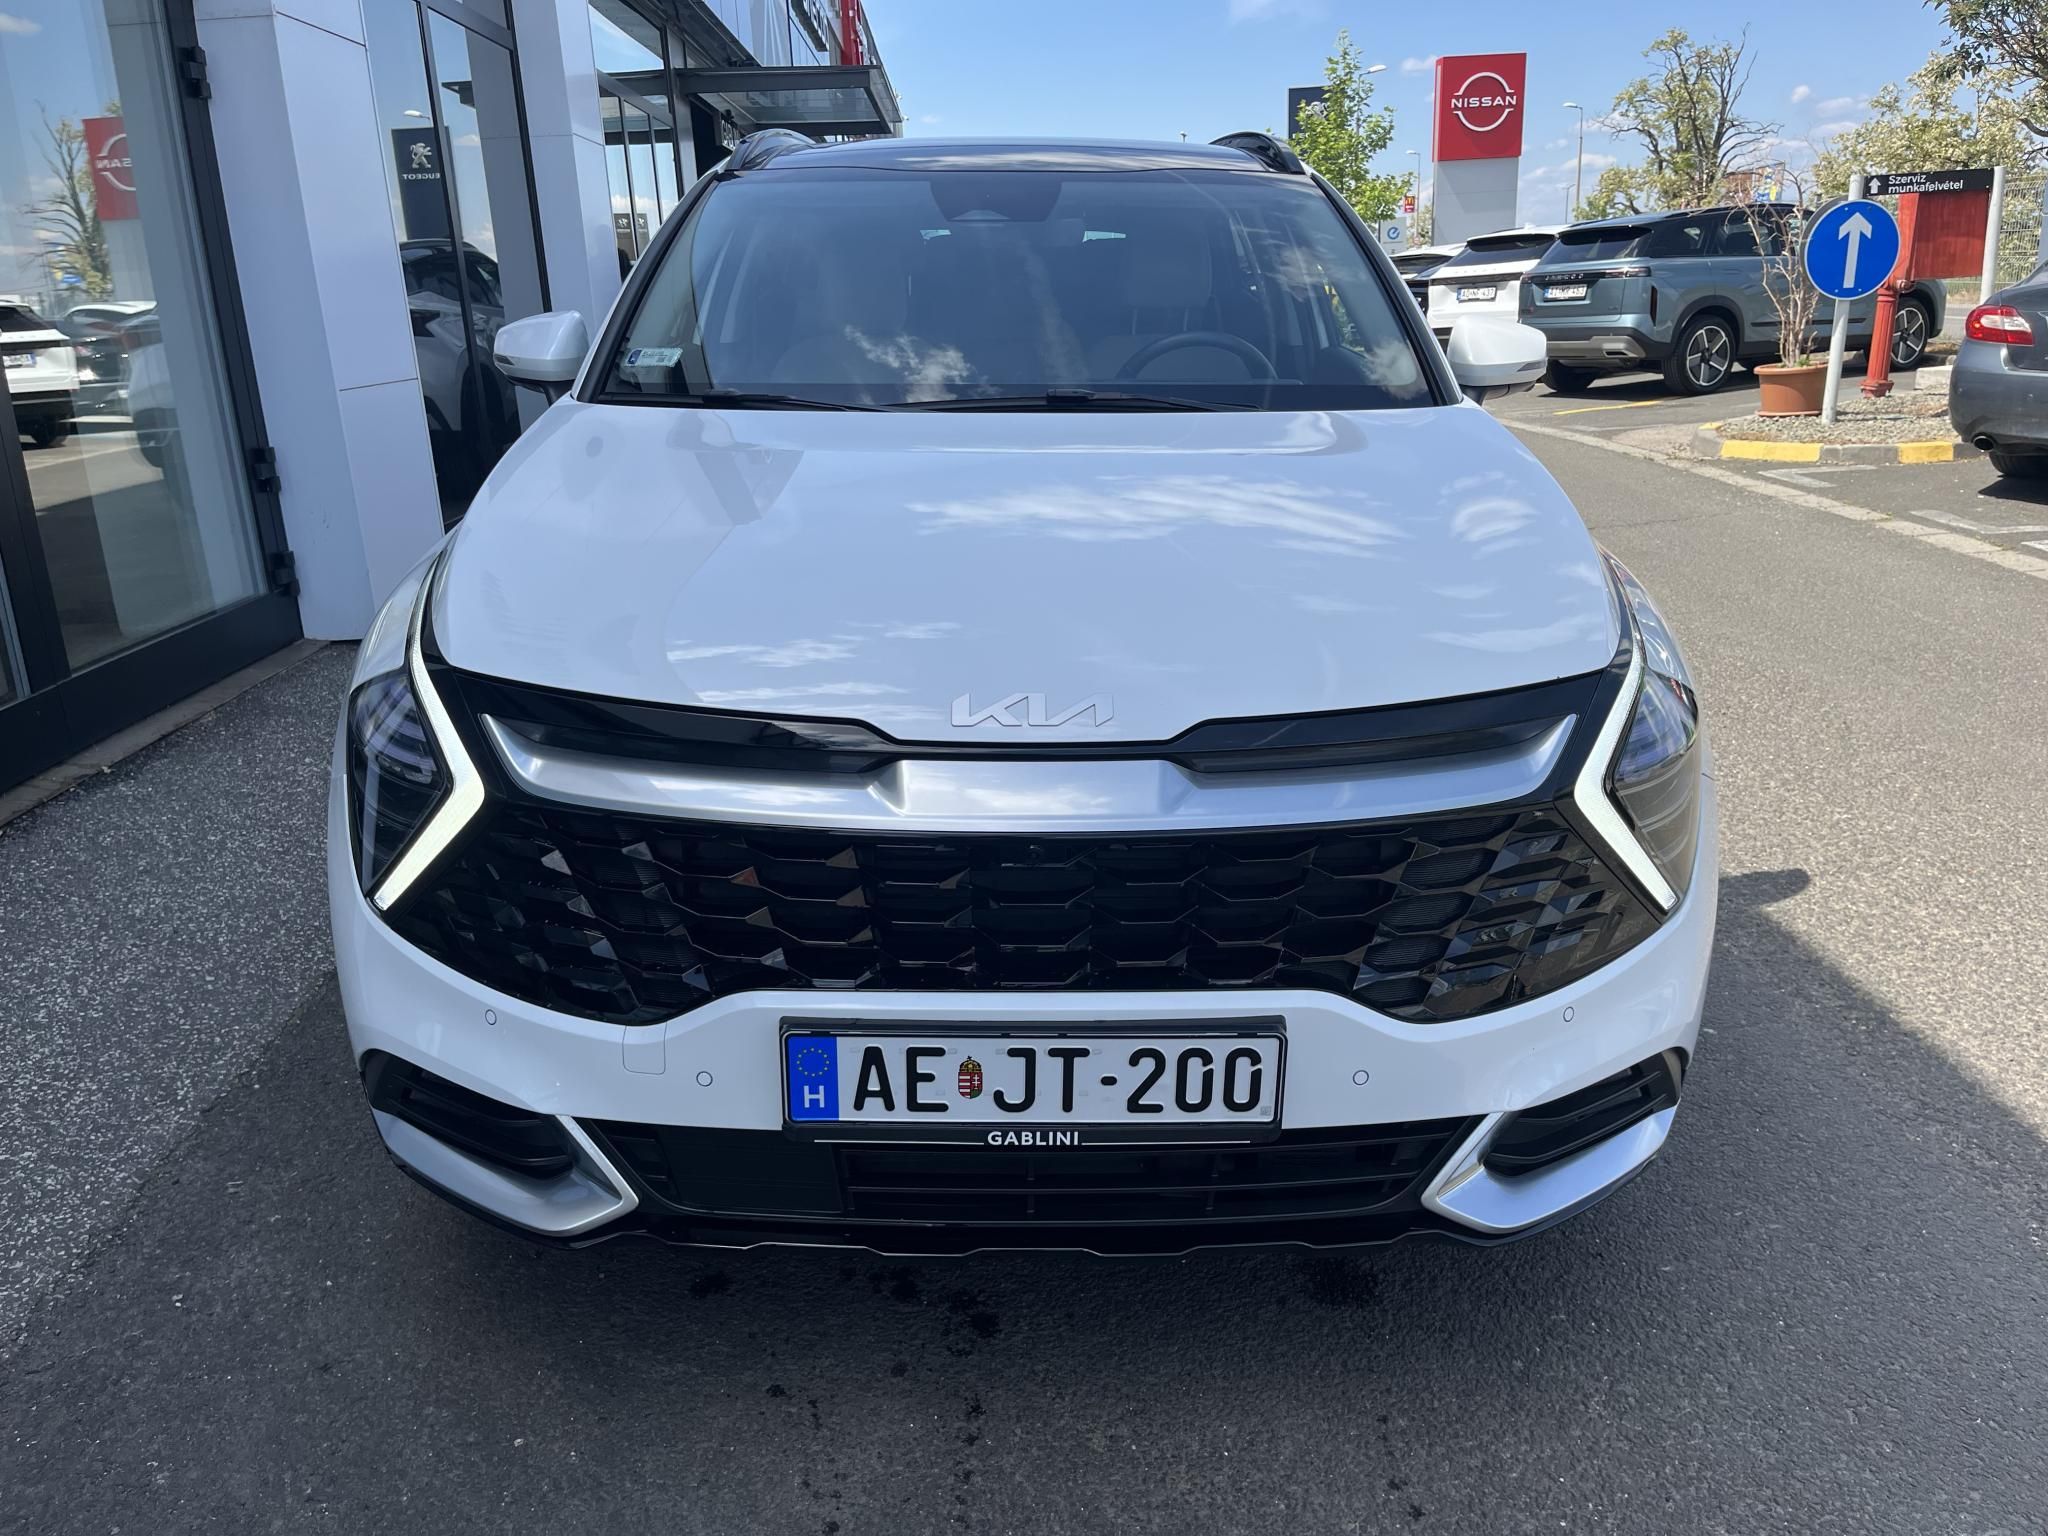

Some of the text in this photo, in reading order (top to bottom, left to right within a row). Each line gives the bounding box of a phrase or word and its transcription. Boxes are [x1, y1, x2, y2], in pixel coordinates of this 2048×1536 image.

[1451, 95, 1517, 109] NISSAN
[1888, 173, 1927, 185] Szerviz
[1888, 179, 1963, 194] munkafelvétel
[951, 692, 1114, 728] KIA
[853, 1046, 1263, 1113] AE JT-200
[803, 1085, 825, 1108] H
[987, 1131, 1079, 1146] GABLINI
